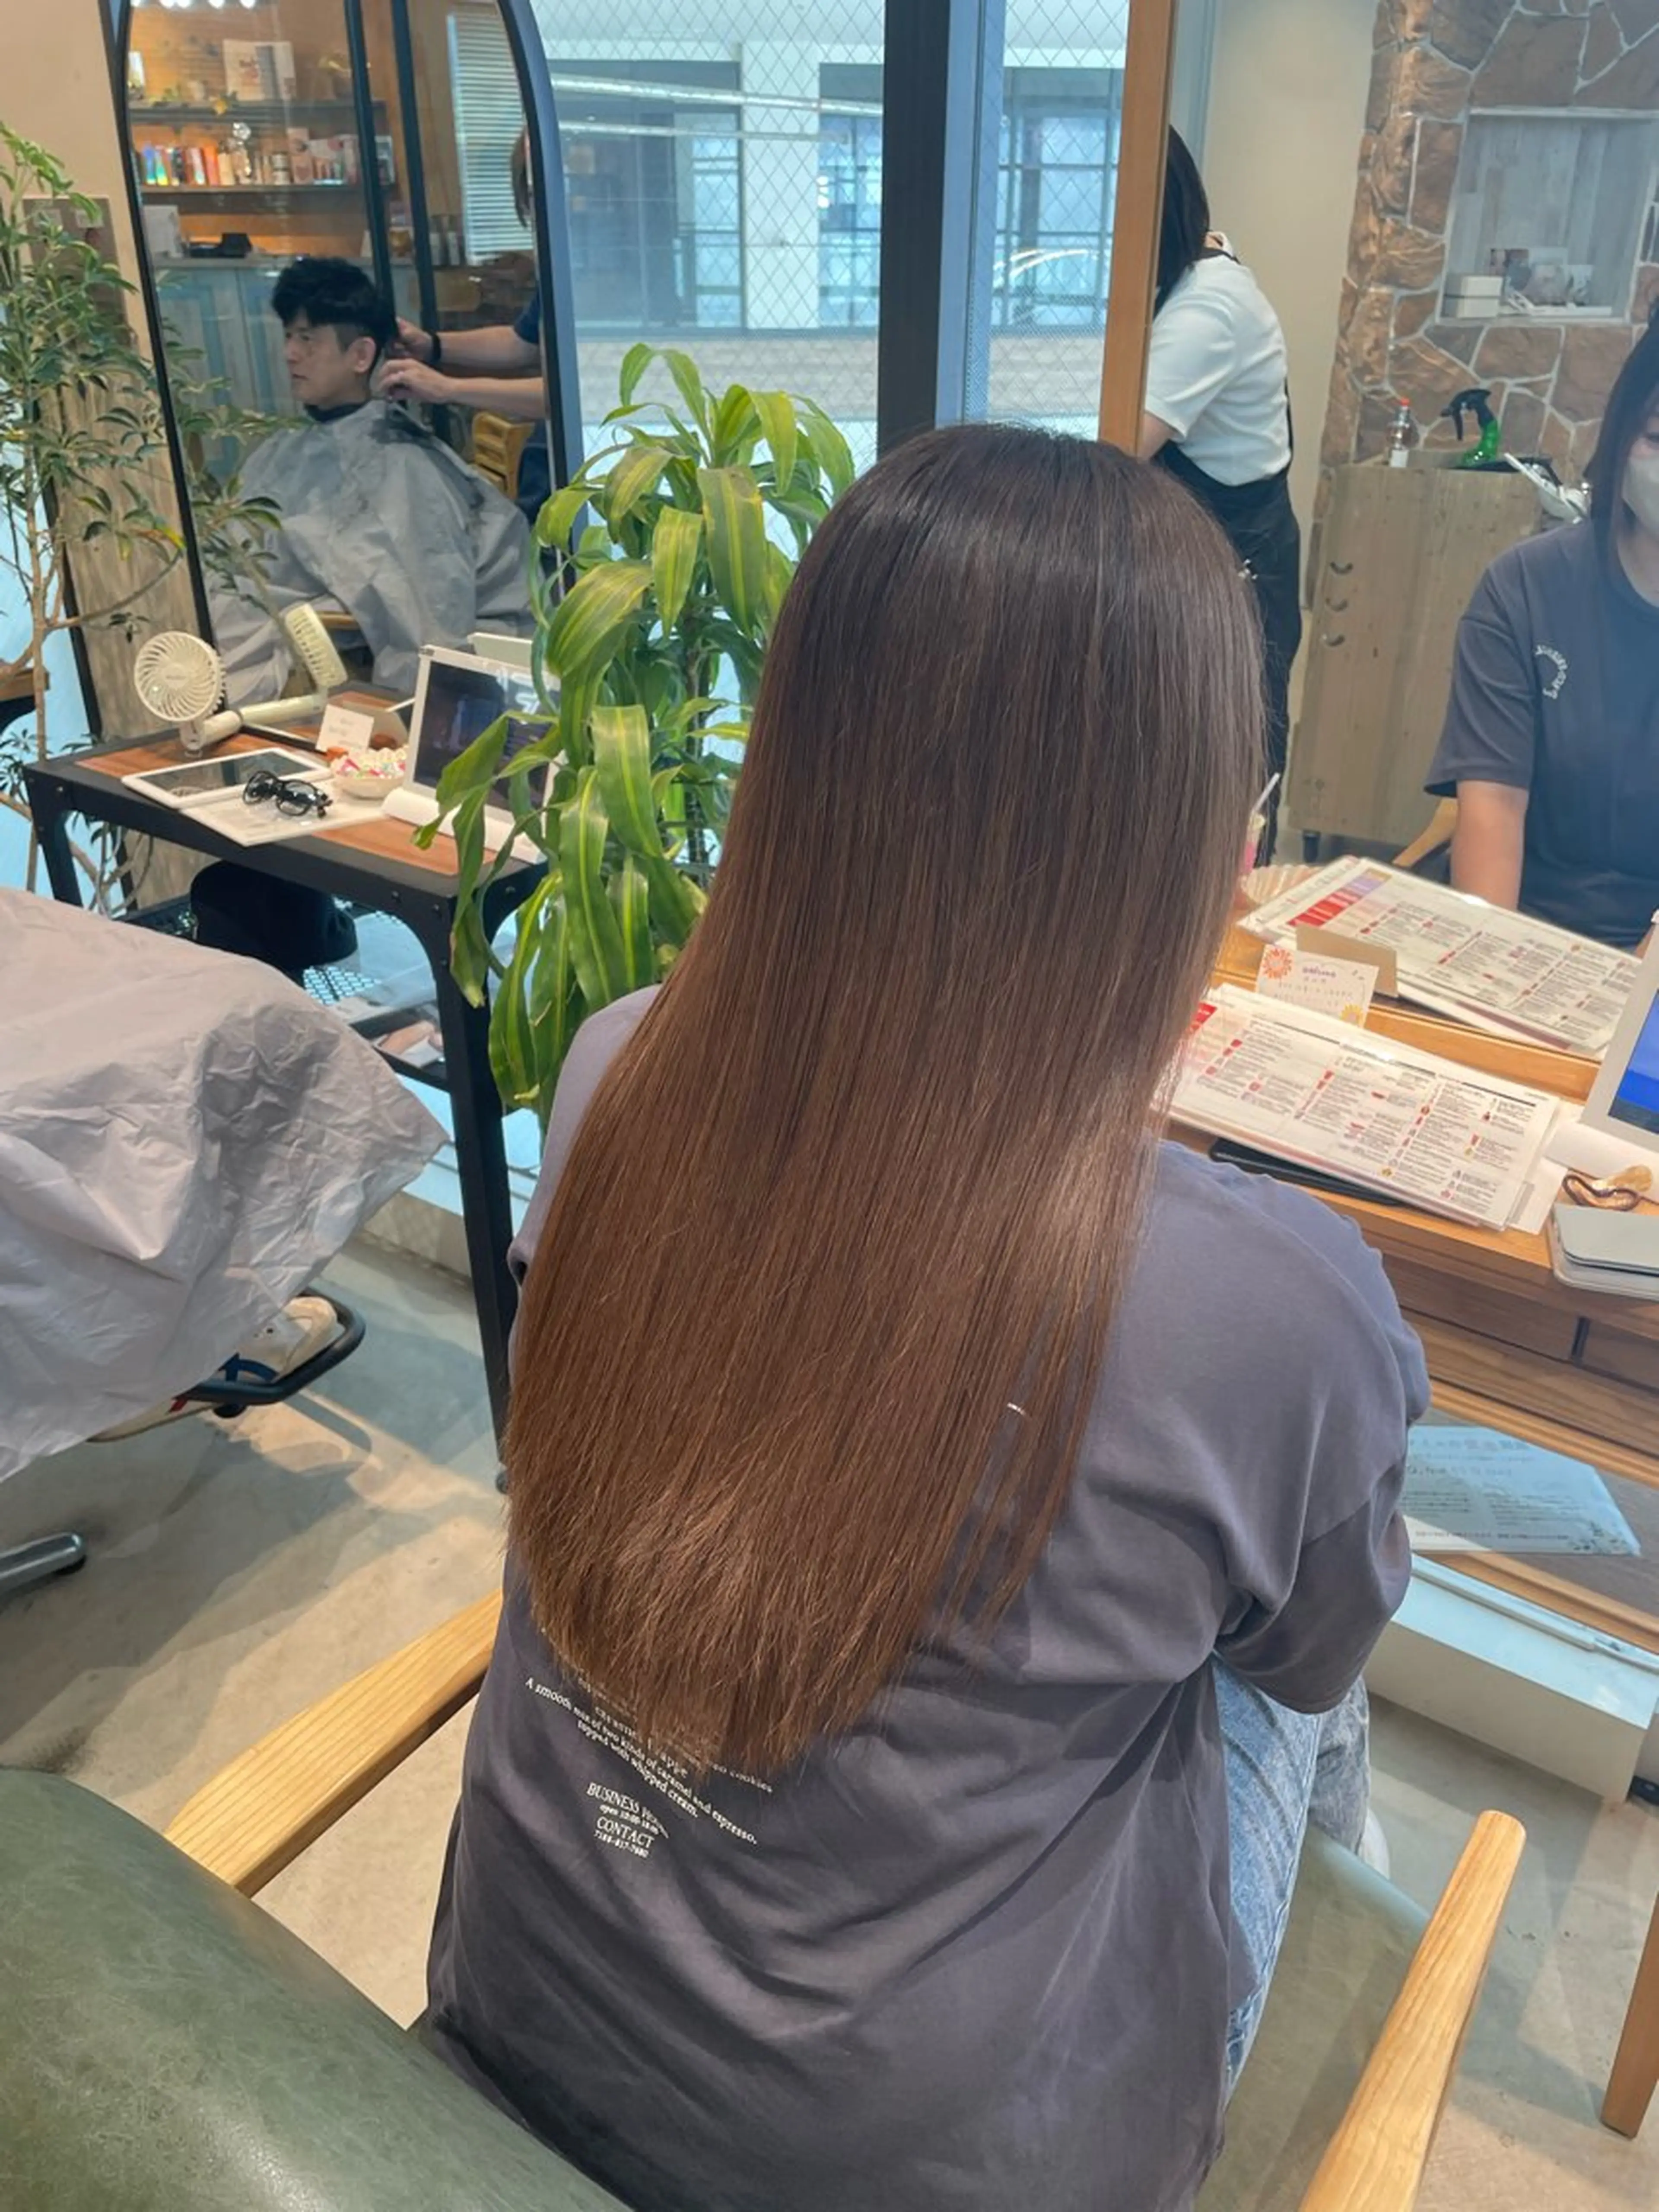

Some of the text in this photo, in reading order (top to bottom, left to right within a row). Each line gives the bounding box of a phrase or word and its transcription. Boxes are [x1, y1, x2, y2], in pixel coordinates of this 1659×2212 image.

[525, 1677, 534, 1689] A
[535, 1684, 572, 1710] smooth
[631, 1757, 668, 1793] whipped
[586, 1781, 640, 1814] BUSINESS
[597, 1816, 655, 1848] CONTACT
